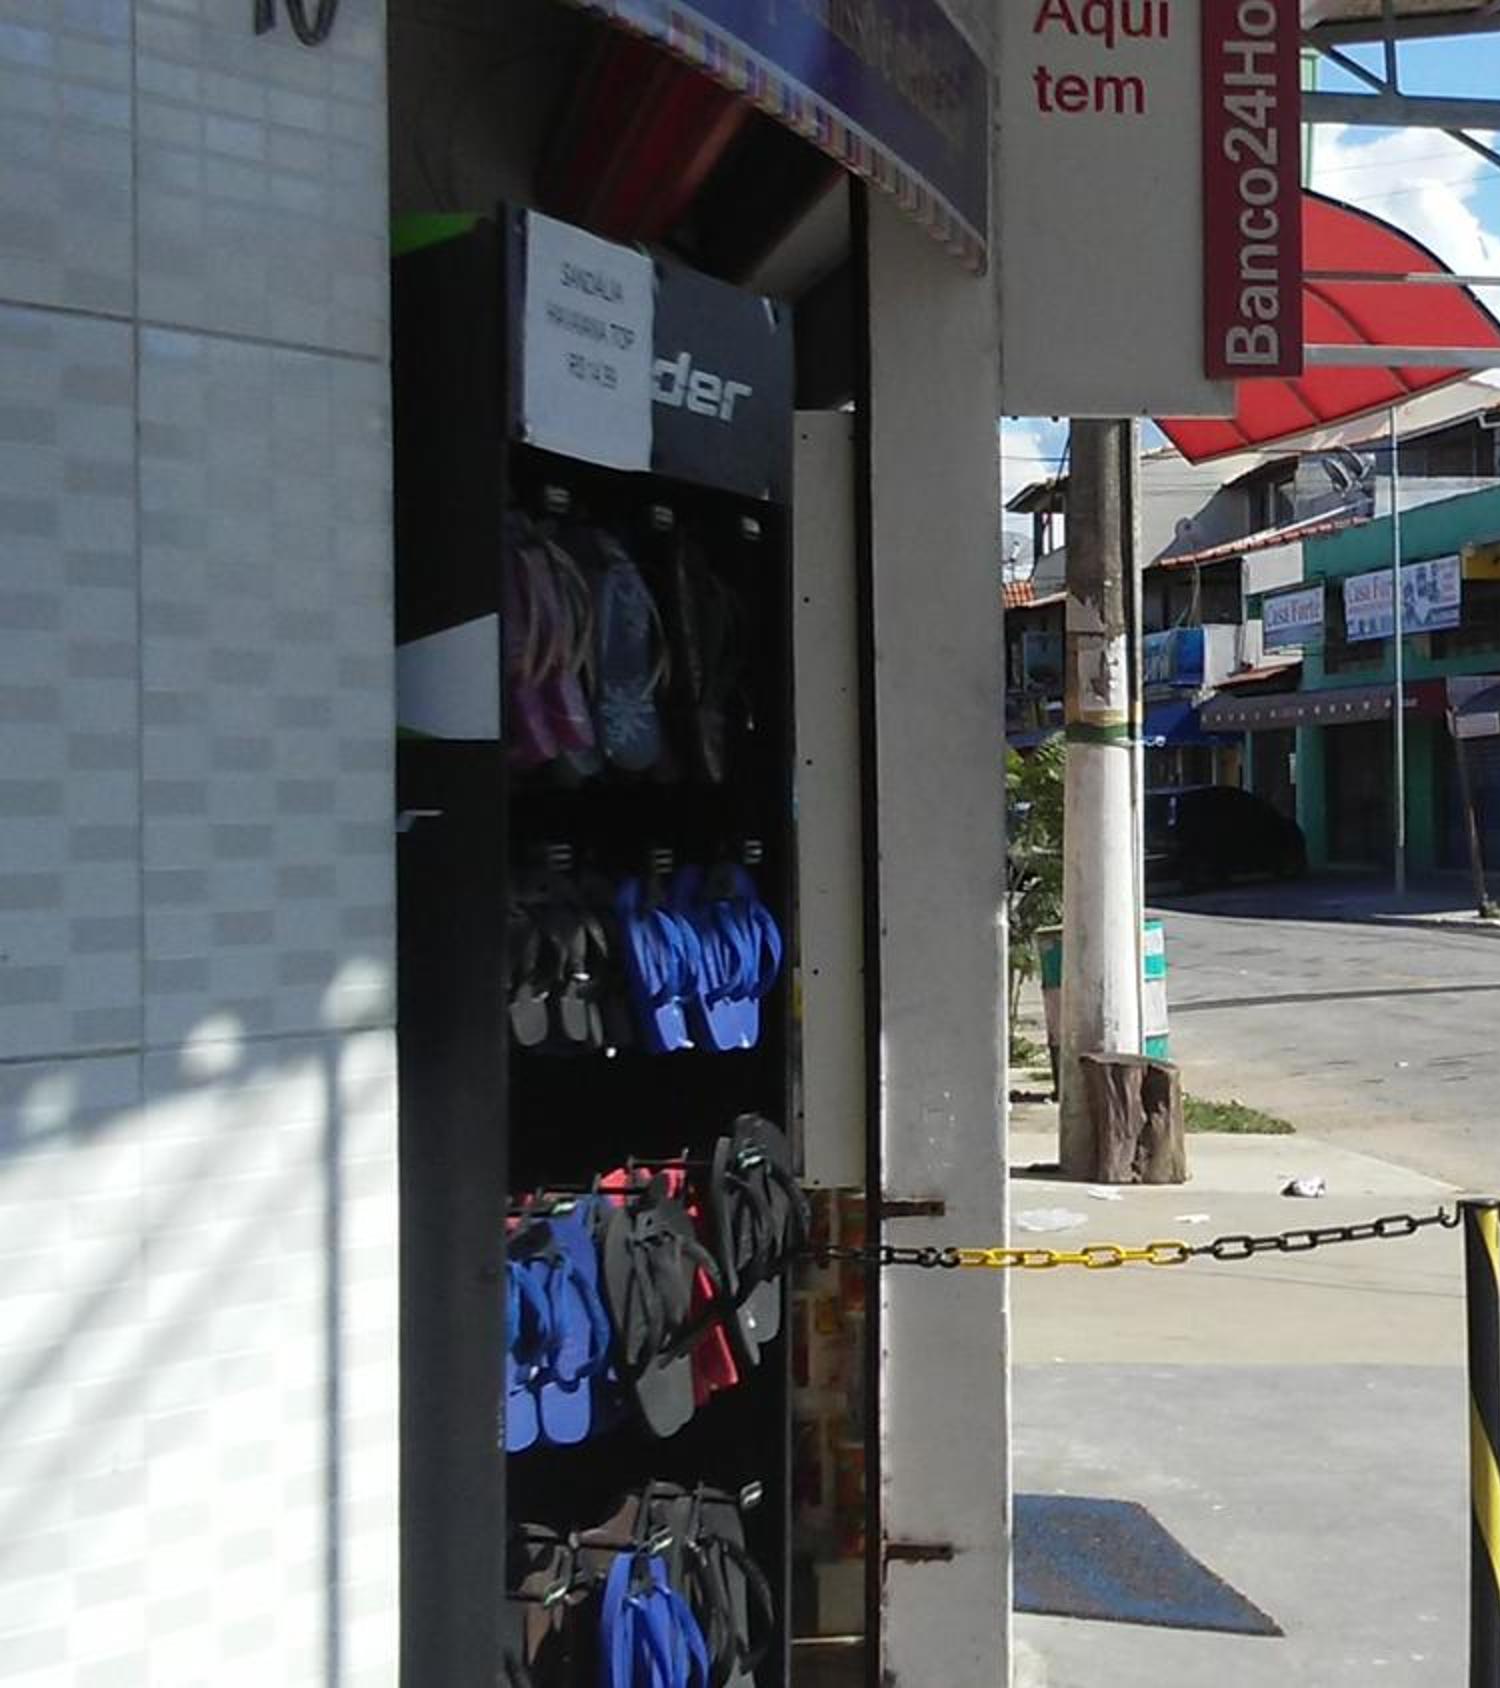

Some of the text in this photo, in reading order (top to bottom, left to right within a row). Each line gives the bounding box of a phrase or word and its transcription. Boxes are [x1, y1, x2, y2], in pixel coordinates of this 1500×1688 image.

[1032, 0, 1169, 49] Aqui
[1033, 65, 1145, 114] tem
[1222, 0, 1280, 365] Banco24Ho
